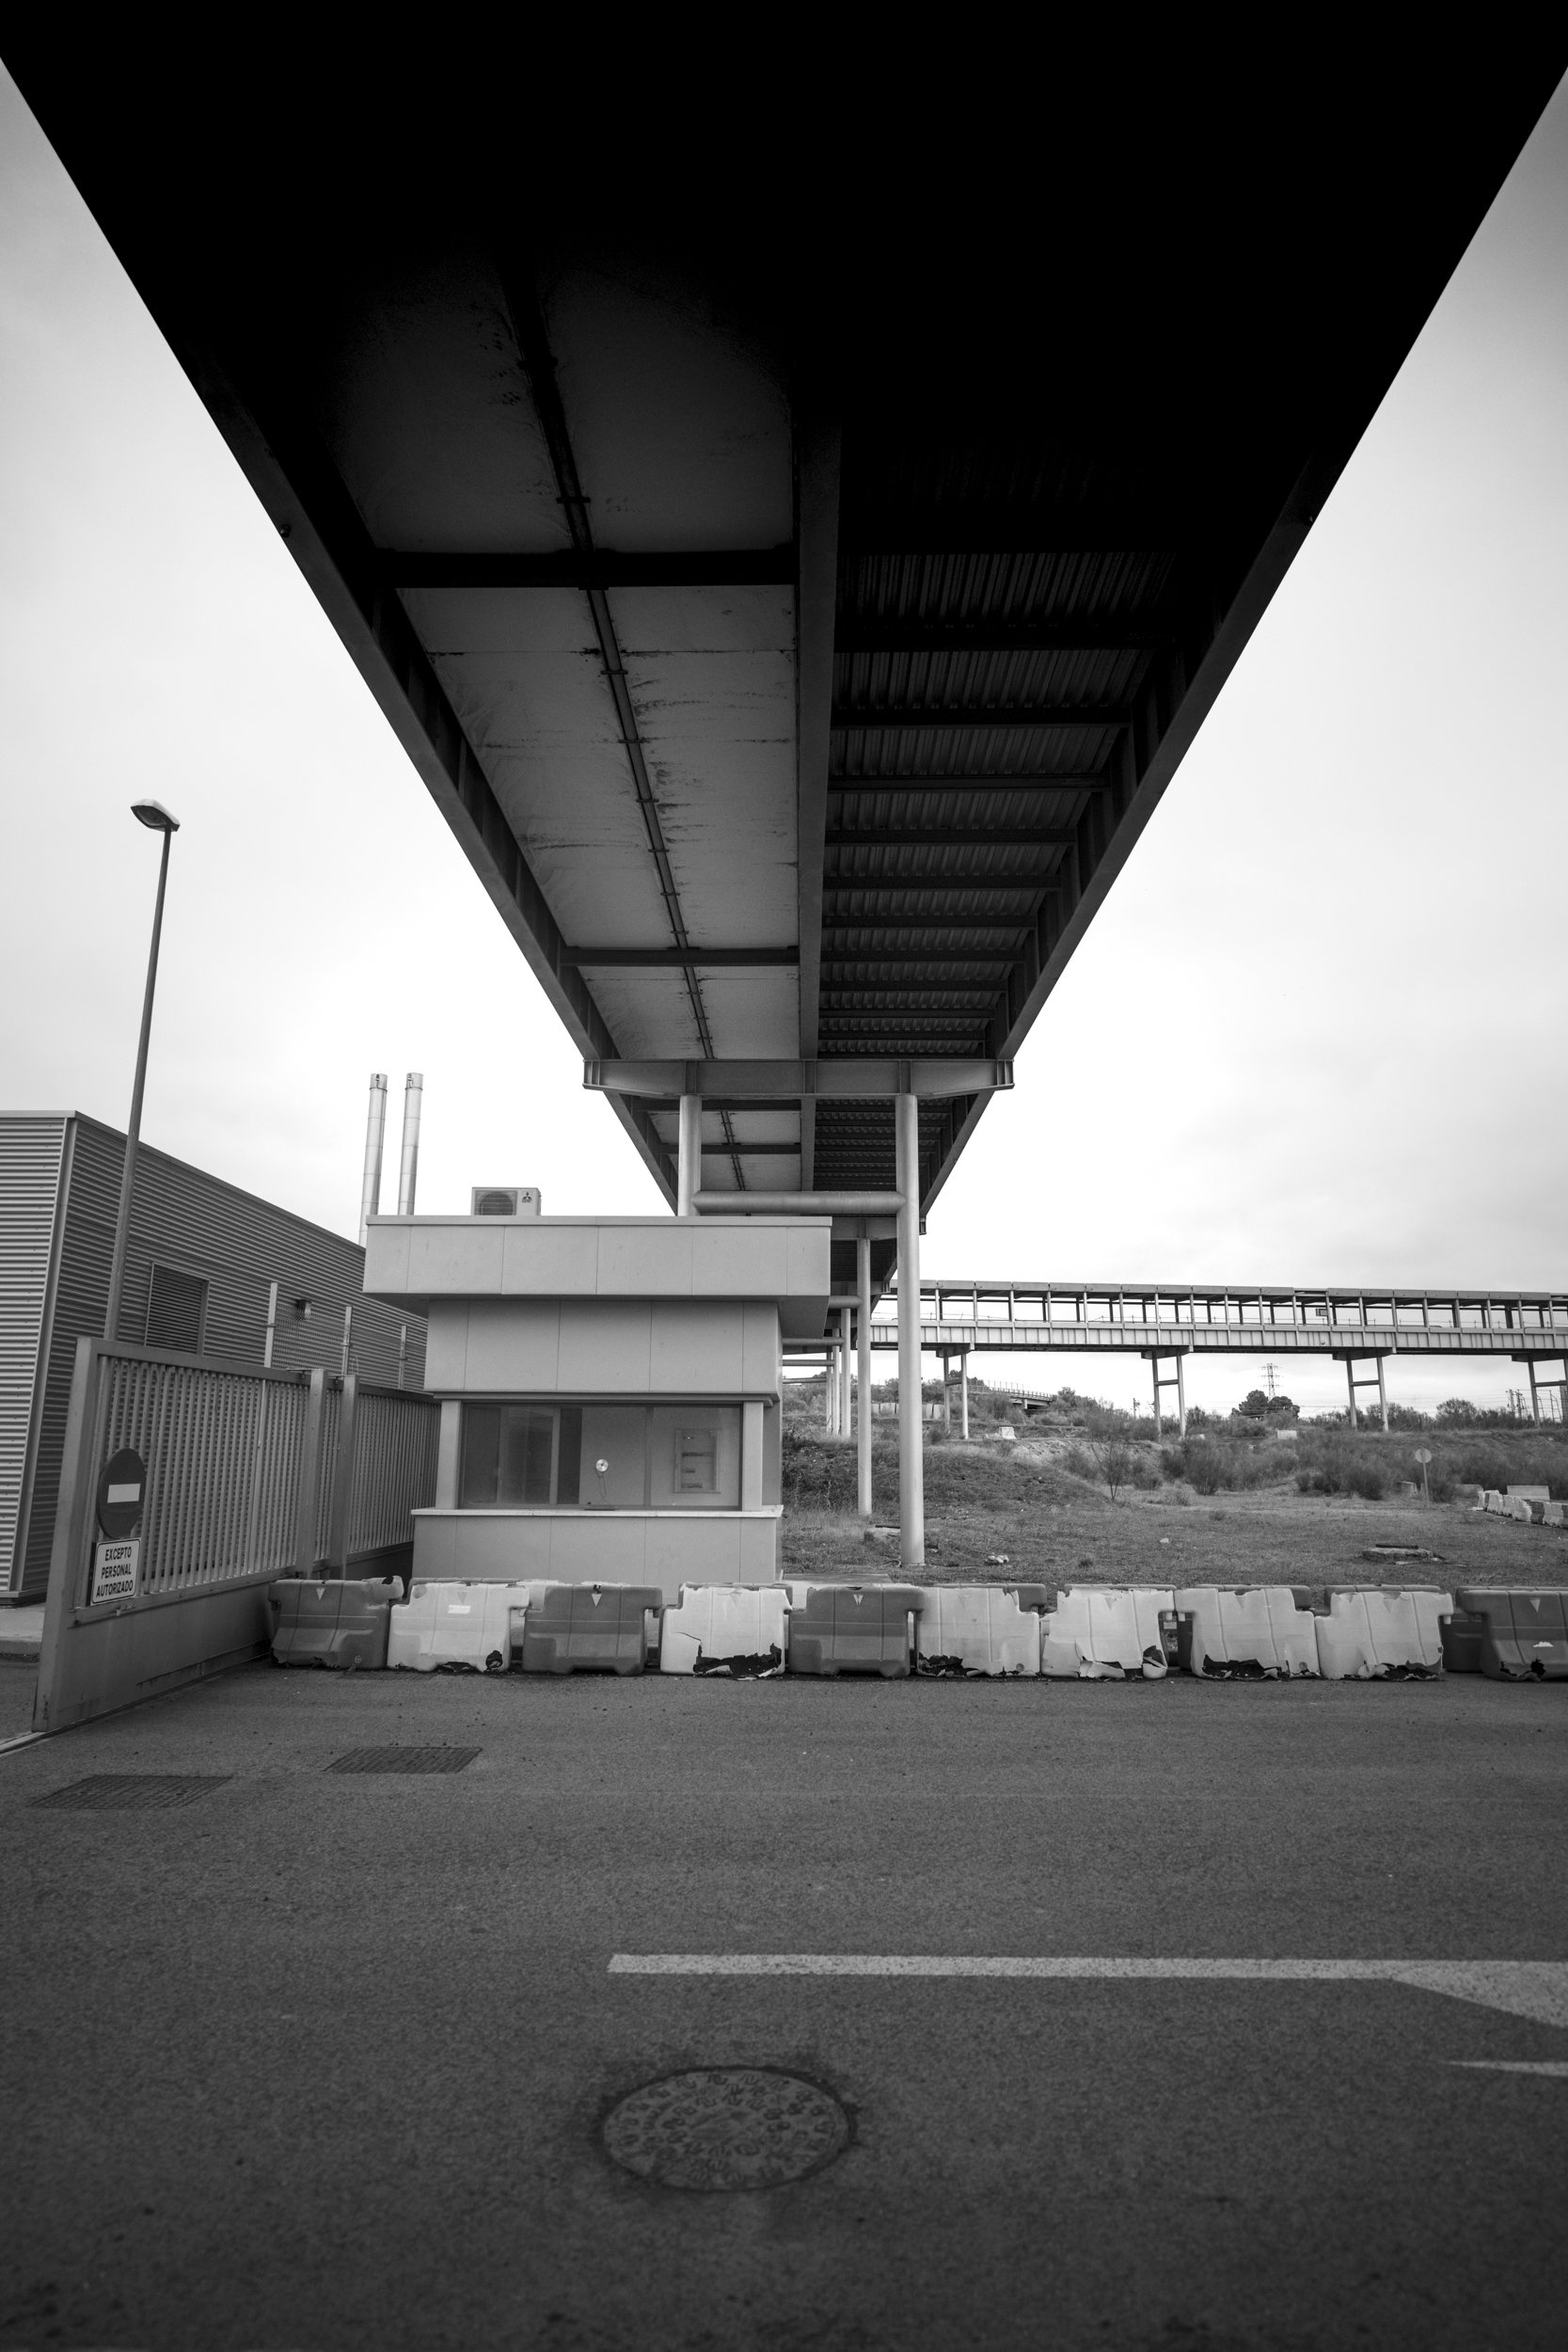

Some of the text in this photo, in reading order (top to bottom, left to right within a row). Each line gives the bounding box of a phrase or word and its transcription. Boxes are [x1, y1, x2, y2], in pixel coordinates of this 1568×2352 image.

[104, 1546, 132, 1562] EXCEPTO
[101, 1564, 132, 1580] PERSONAL
[96, 1580, 134, 1597] AUTORIZADO
